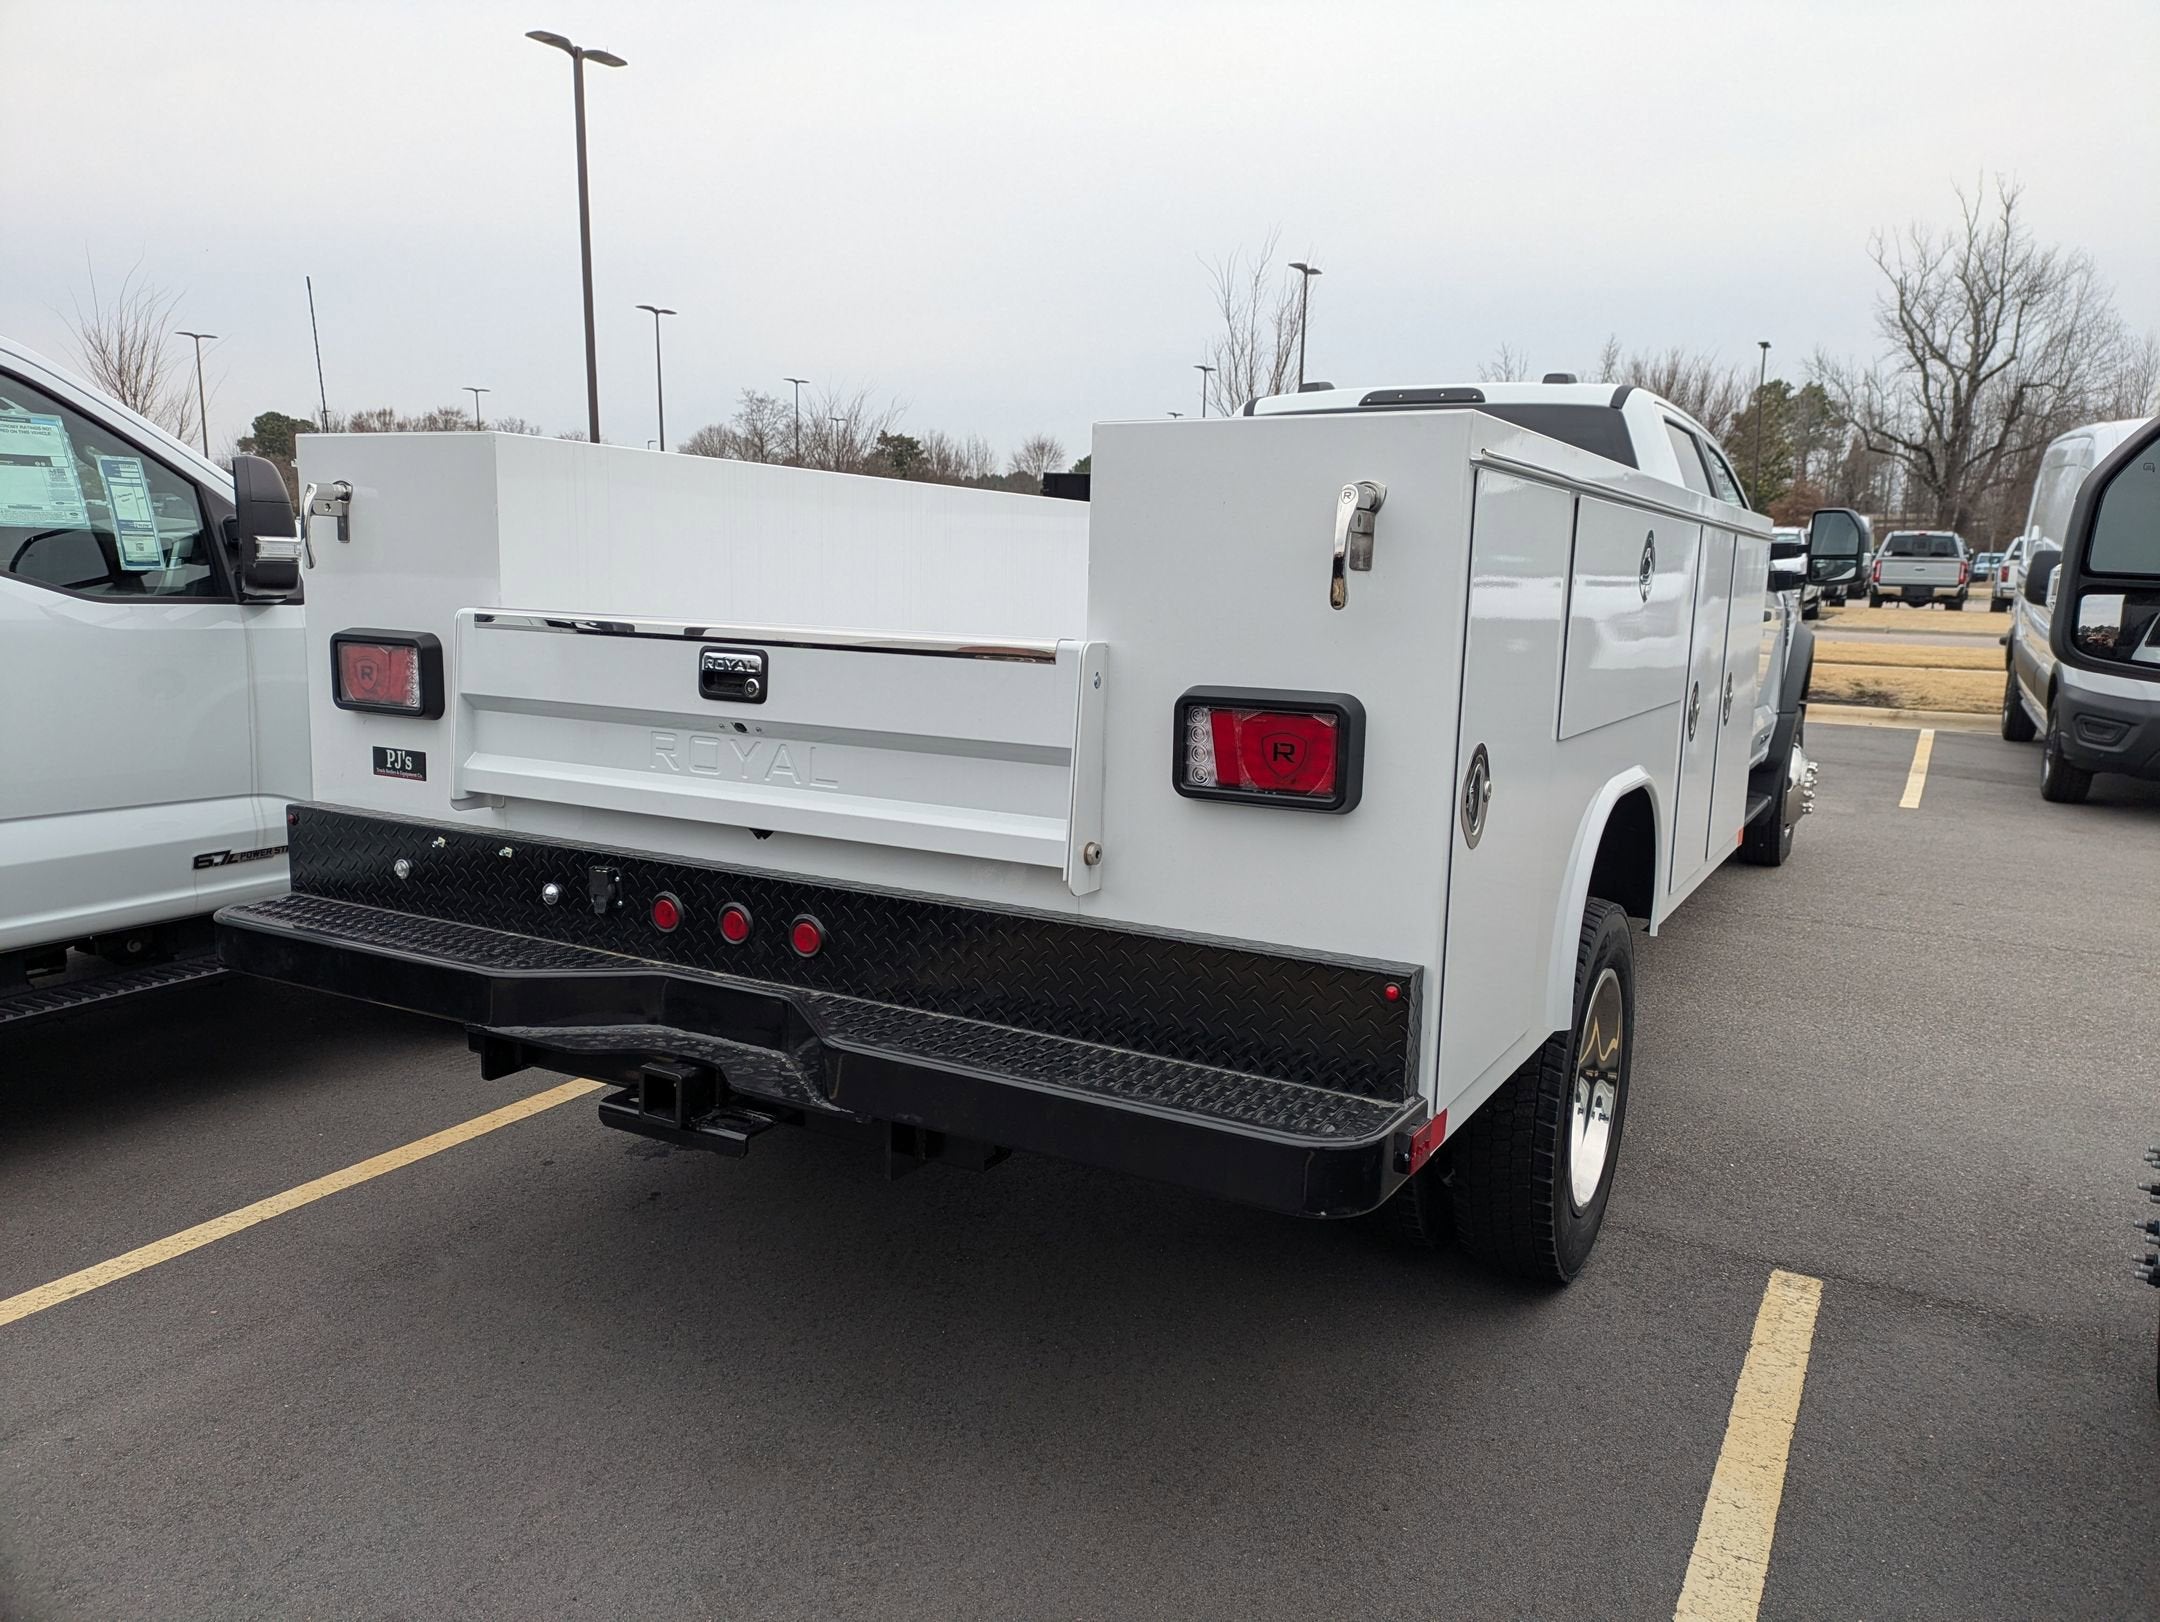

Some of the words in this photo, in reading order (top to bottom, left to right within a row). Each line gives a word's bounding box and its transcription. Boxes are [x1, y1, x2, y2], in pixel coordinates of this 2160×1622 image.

[361, 665, 373, 680] R
[704, 657, 757, 673] ROYAL
[385, 749, 413, 771] PJ's
[649, 730, 839, 790] ROYAL
[1273, 742, 1295, 764] R
[240, 848, 273, 861] POWER
